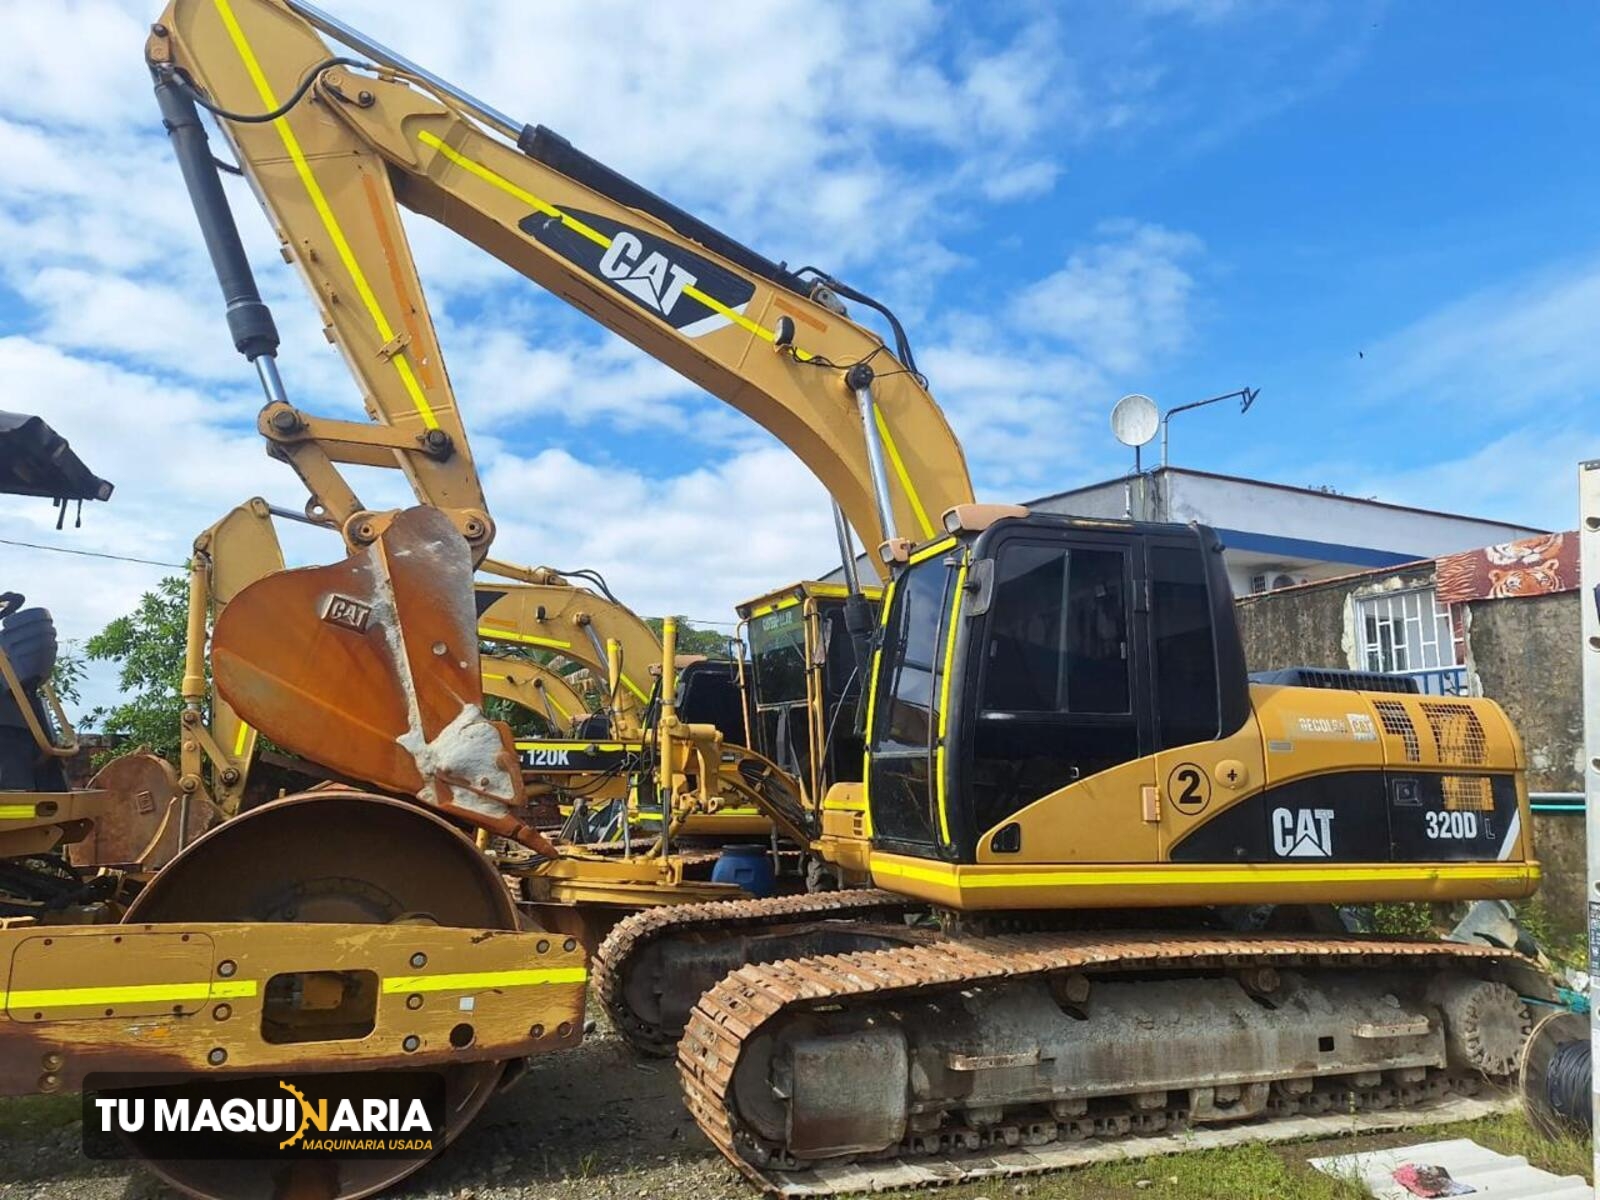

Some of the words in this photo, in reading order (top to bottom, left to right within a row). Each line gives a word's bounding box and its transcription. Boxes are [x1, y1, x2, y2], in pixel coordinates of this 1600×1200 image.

[599, 231, 698, 316] CAT
[331, 601, 369, 627] CAT
[527, 749, 570, 766] 120K
[1178, 769, 1203, 804] 2
[1272, 807, 1335, 857] CAT
[1425, 811, 1478, 839] 320D
